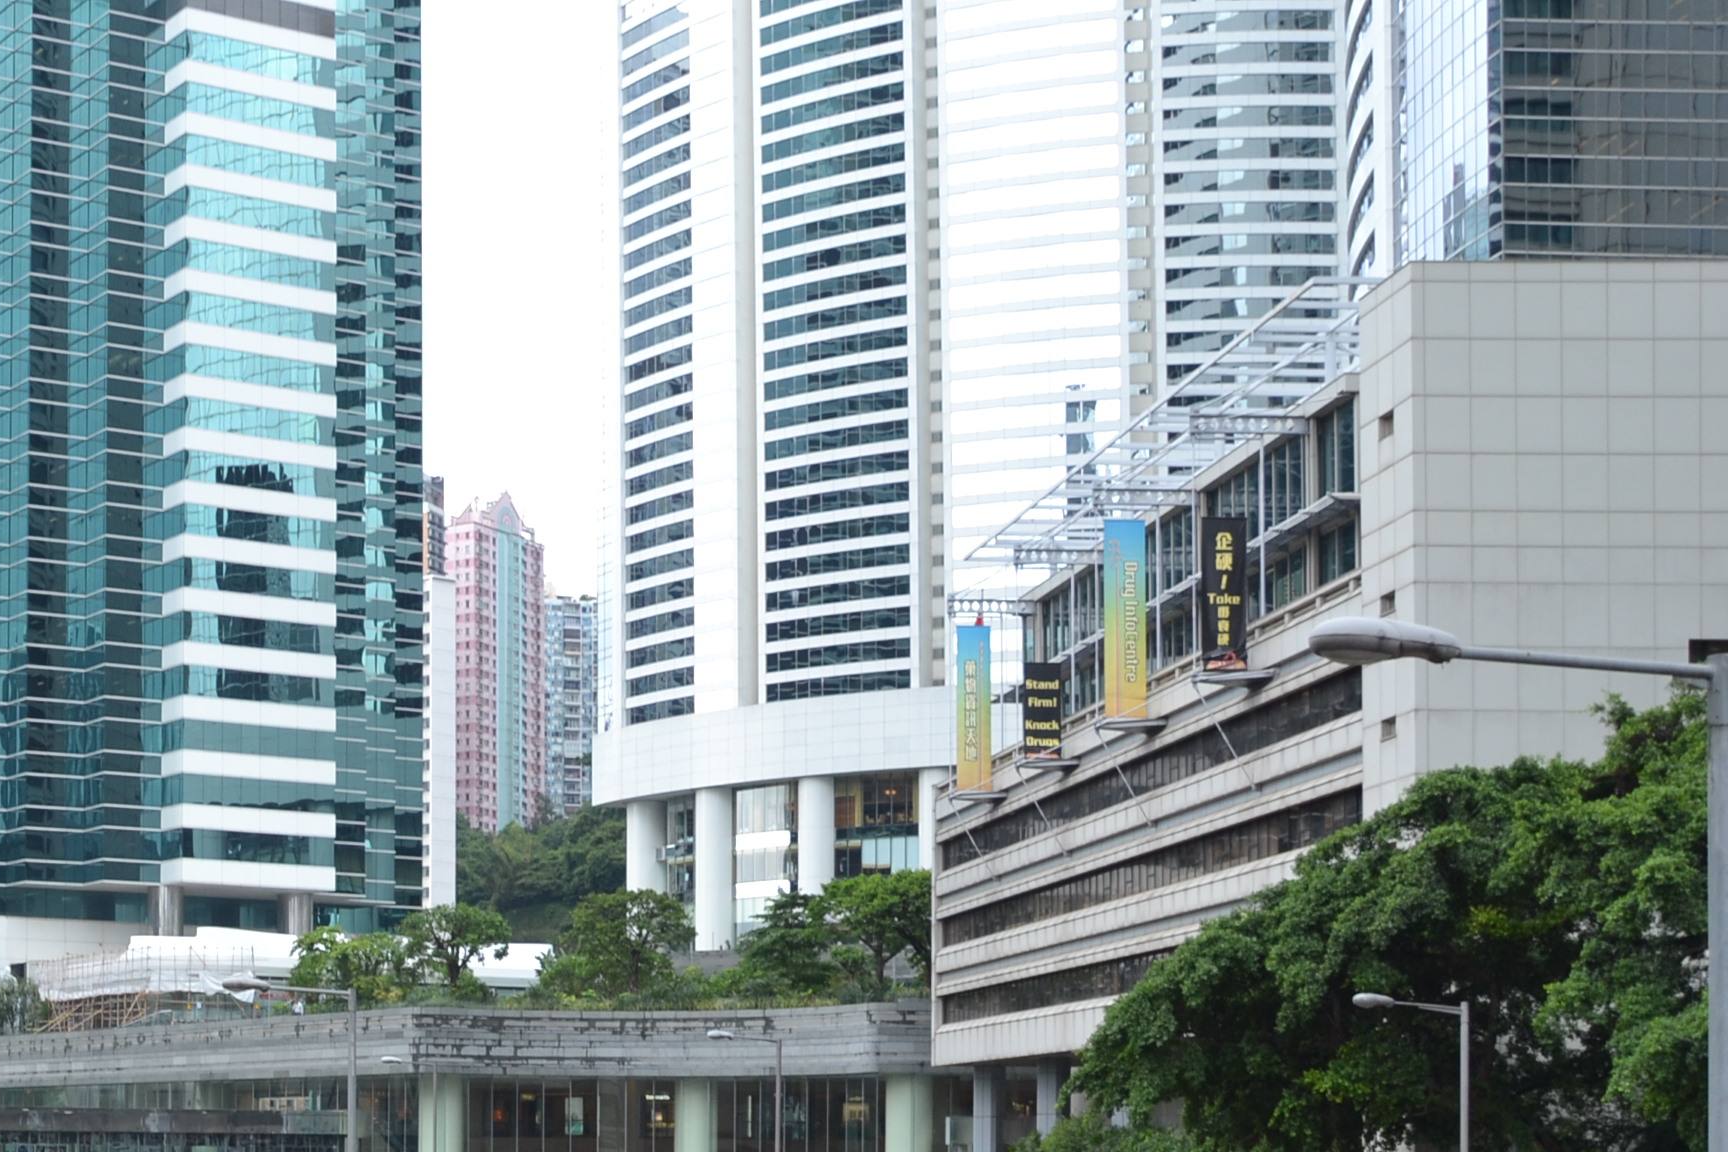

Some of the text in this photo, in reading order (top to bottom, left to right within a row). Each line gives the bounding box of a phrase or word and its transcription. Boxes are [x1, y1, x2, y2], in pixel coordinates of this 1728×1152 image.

[1207, 593, 1241, 605] Take
[1122, 561, 1139, 684] Drug InfoCentre
[1025, 679, 1060, 690] Stand
[1028, 697, 1058, 708] Firm!
[1025, 719, 1060, 731] Knock
[1026, 736, 1060, 747] Drugs
